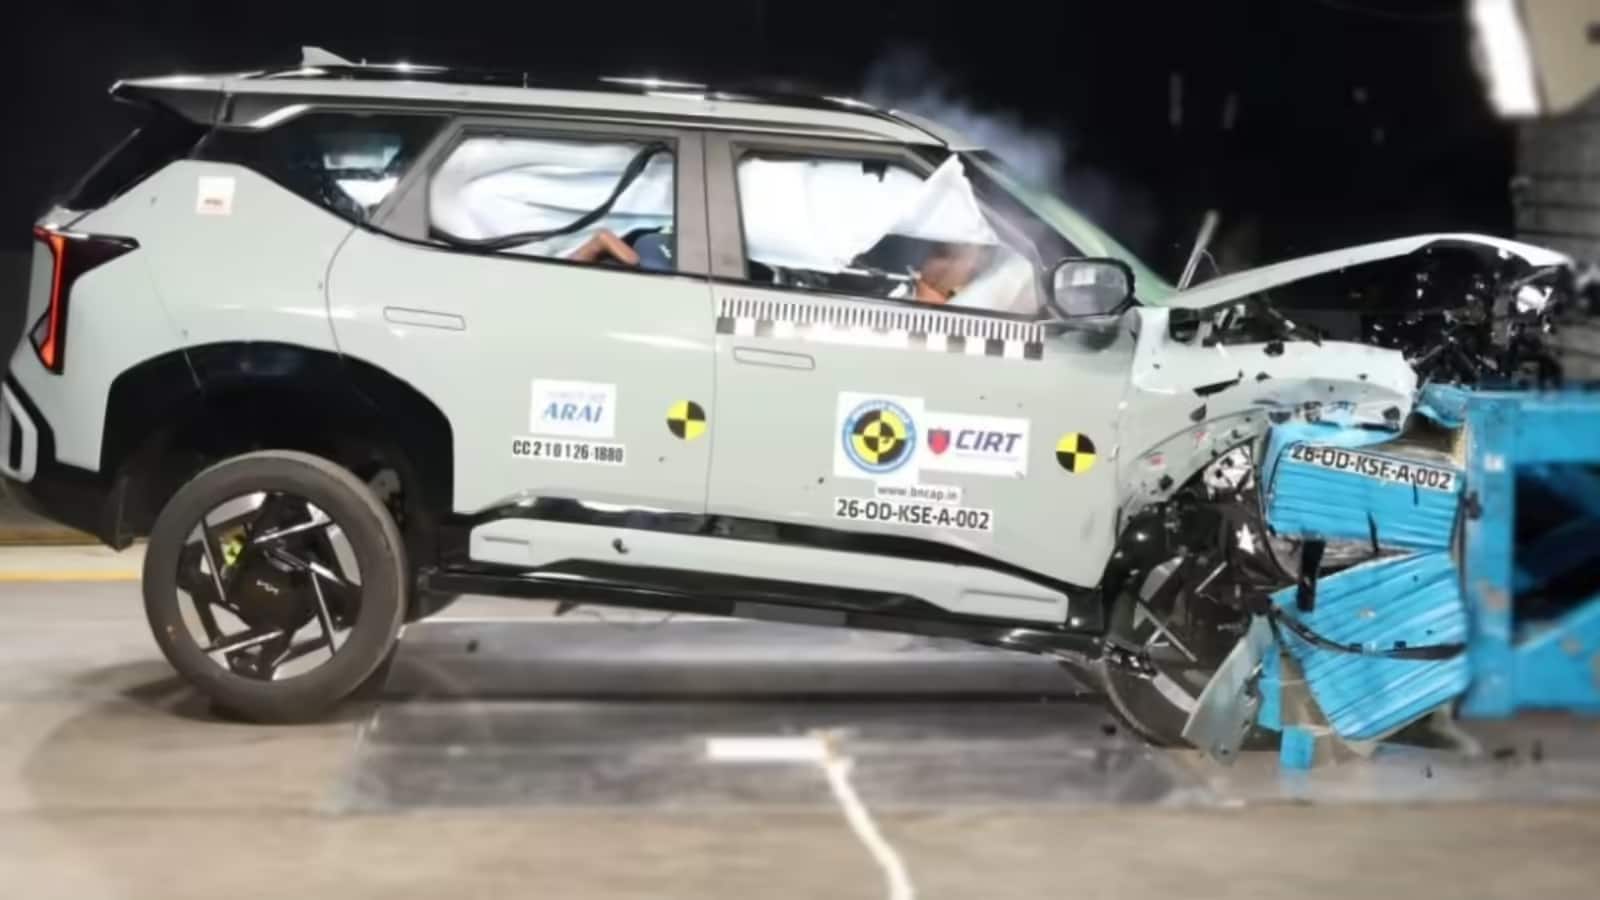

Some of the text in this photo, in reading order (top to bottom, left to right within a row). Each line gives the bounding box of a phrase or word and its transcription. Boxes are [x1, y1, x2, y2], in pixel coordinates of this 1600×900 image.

[543, 402, 603, 423] ARAI
[955, 430, 1022, 453] CIRT
[836, 499, 990, 530] 26-OD-KSE-A-002
